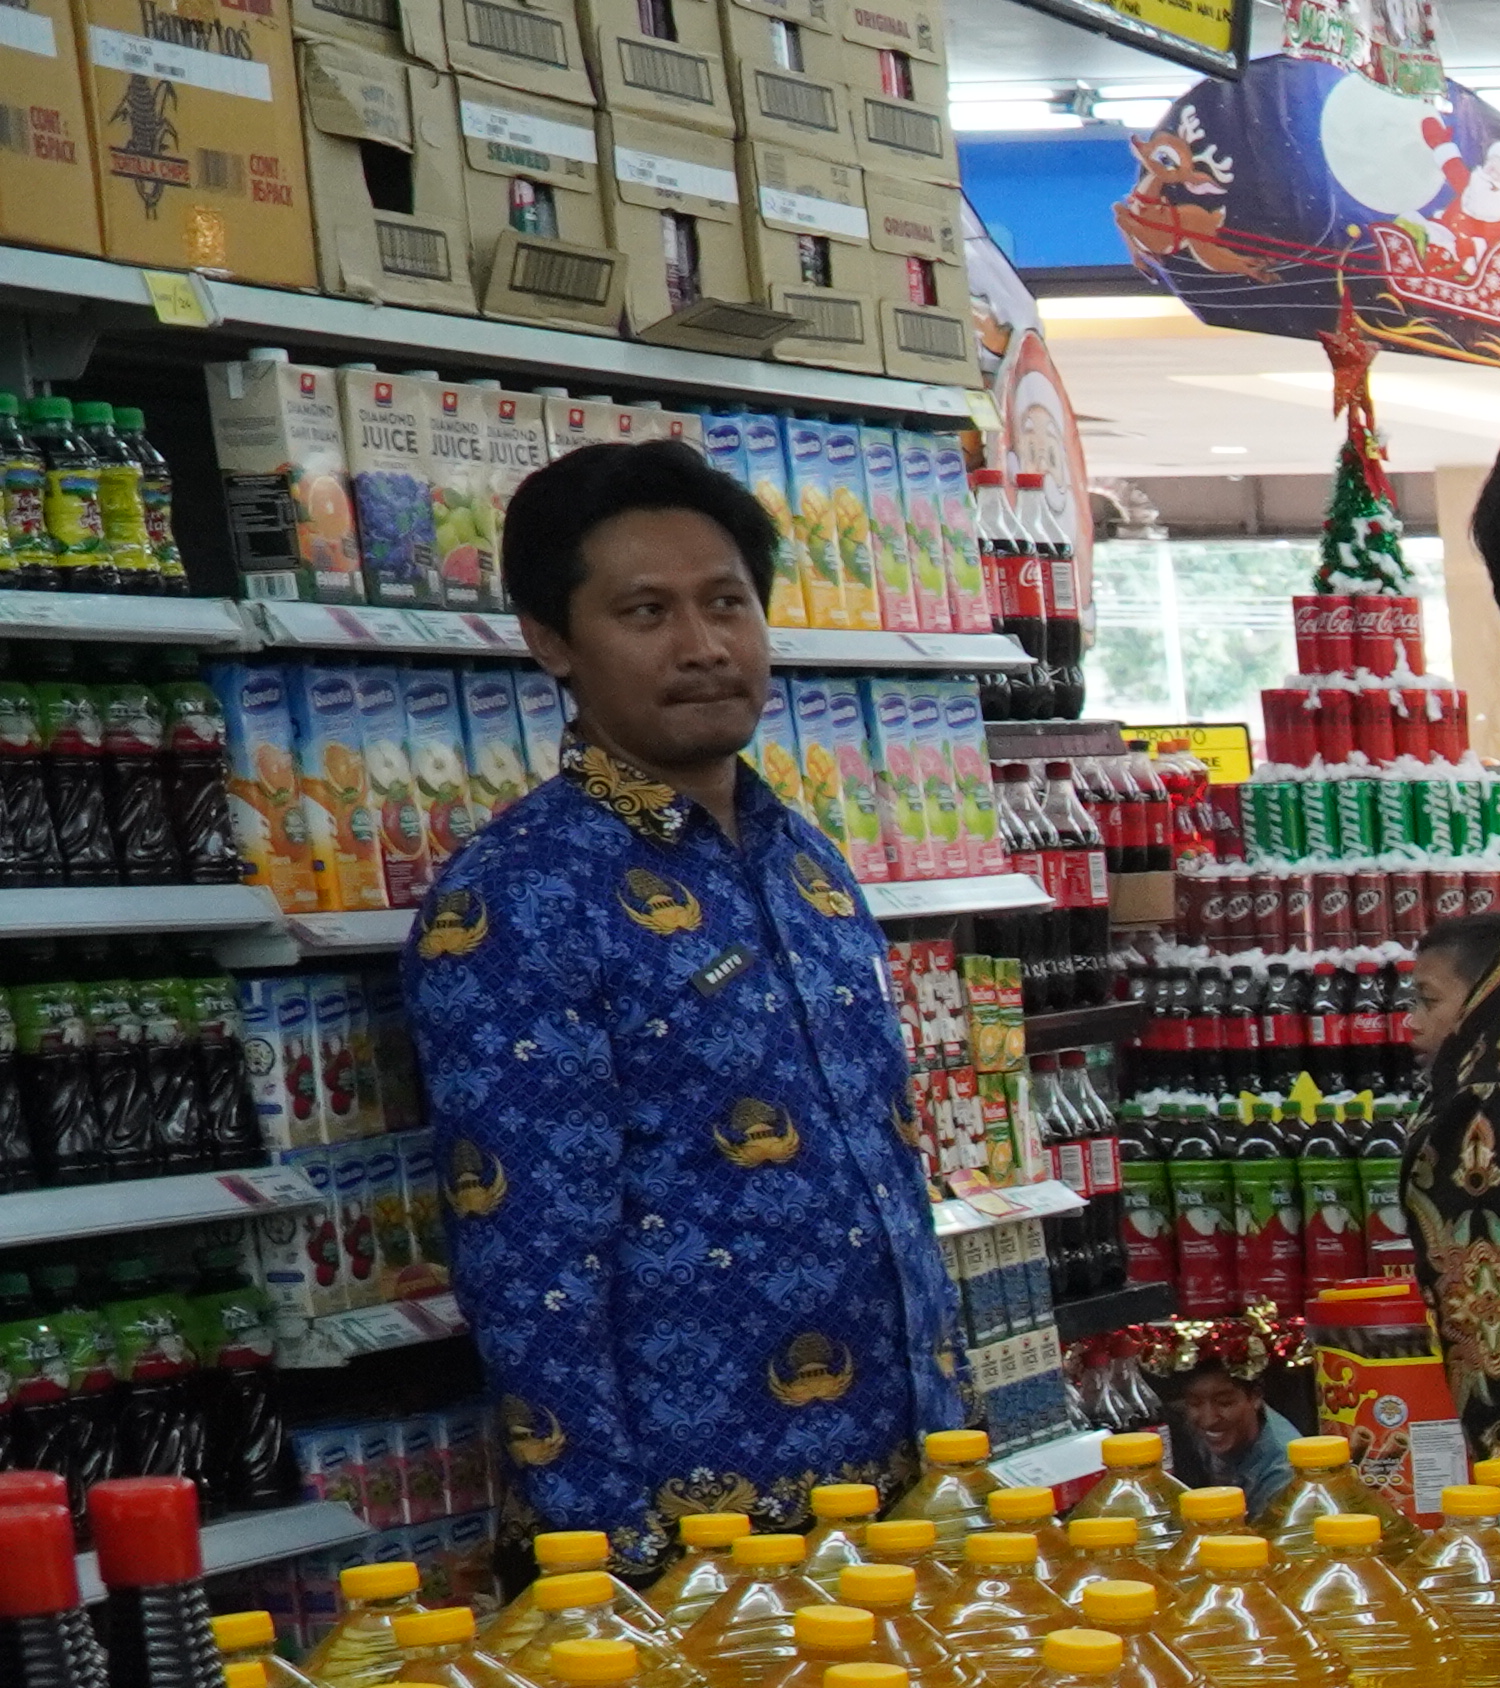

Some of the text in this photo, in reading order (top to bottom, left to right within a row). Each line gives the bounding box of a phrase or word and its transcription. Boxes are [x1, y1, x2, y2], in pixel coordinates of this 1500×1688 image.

[854, 8, 911, 39] ORIGINAL
[883, 216, 935, 243] ORIGINAL
[361, 426, 418, 453] JUICE
[431, 435, 482, 462] JUICE
[489, 441, 540, 466] JUICE
